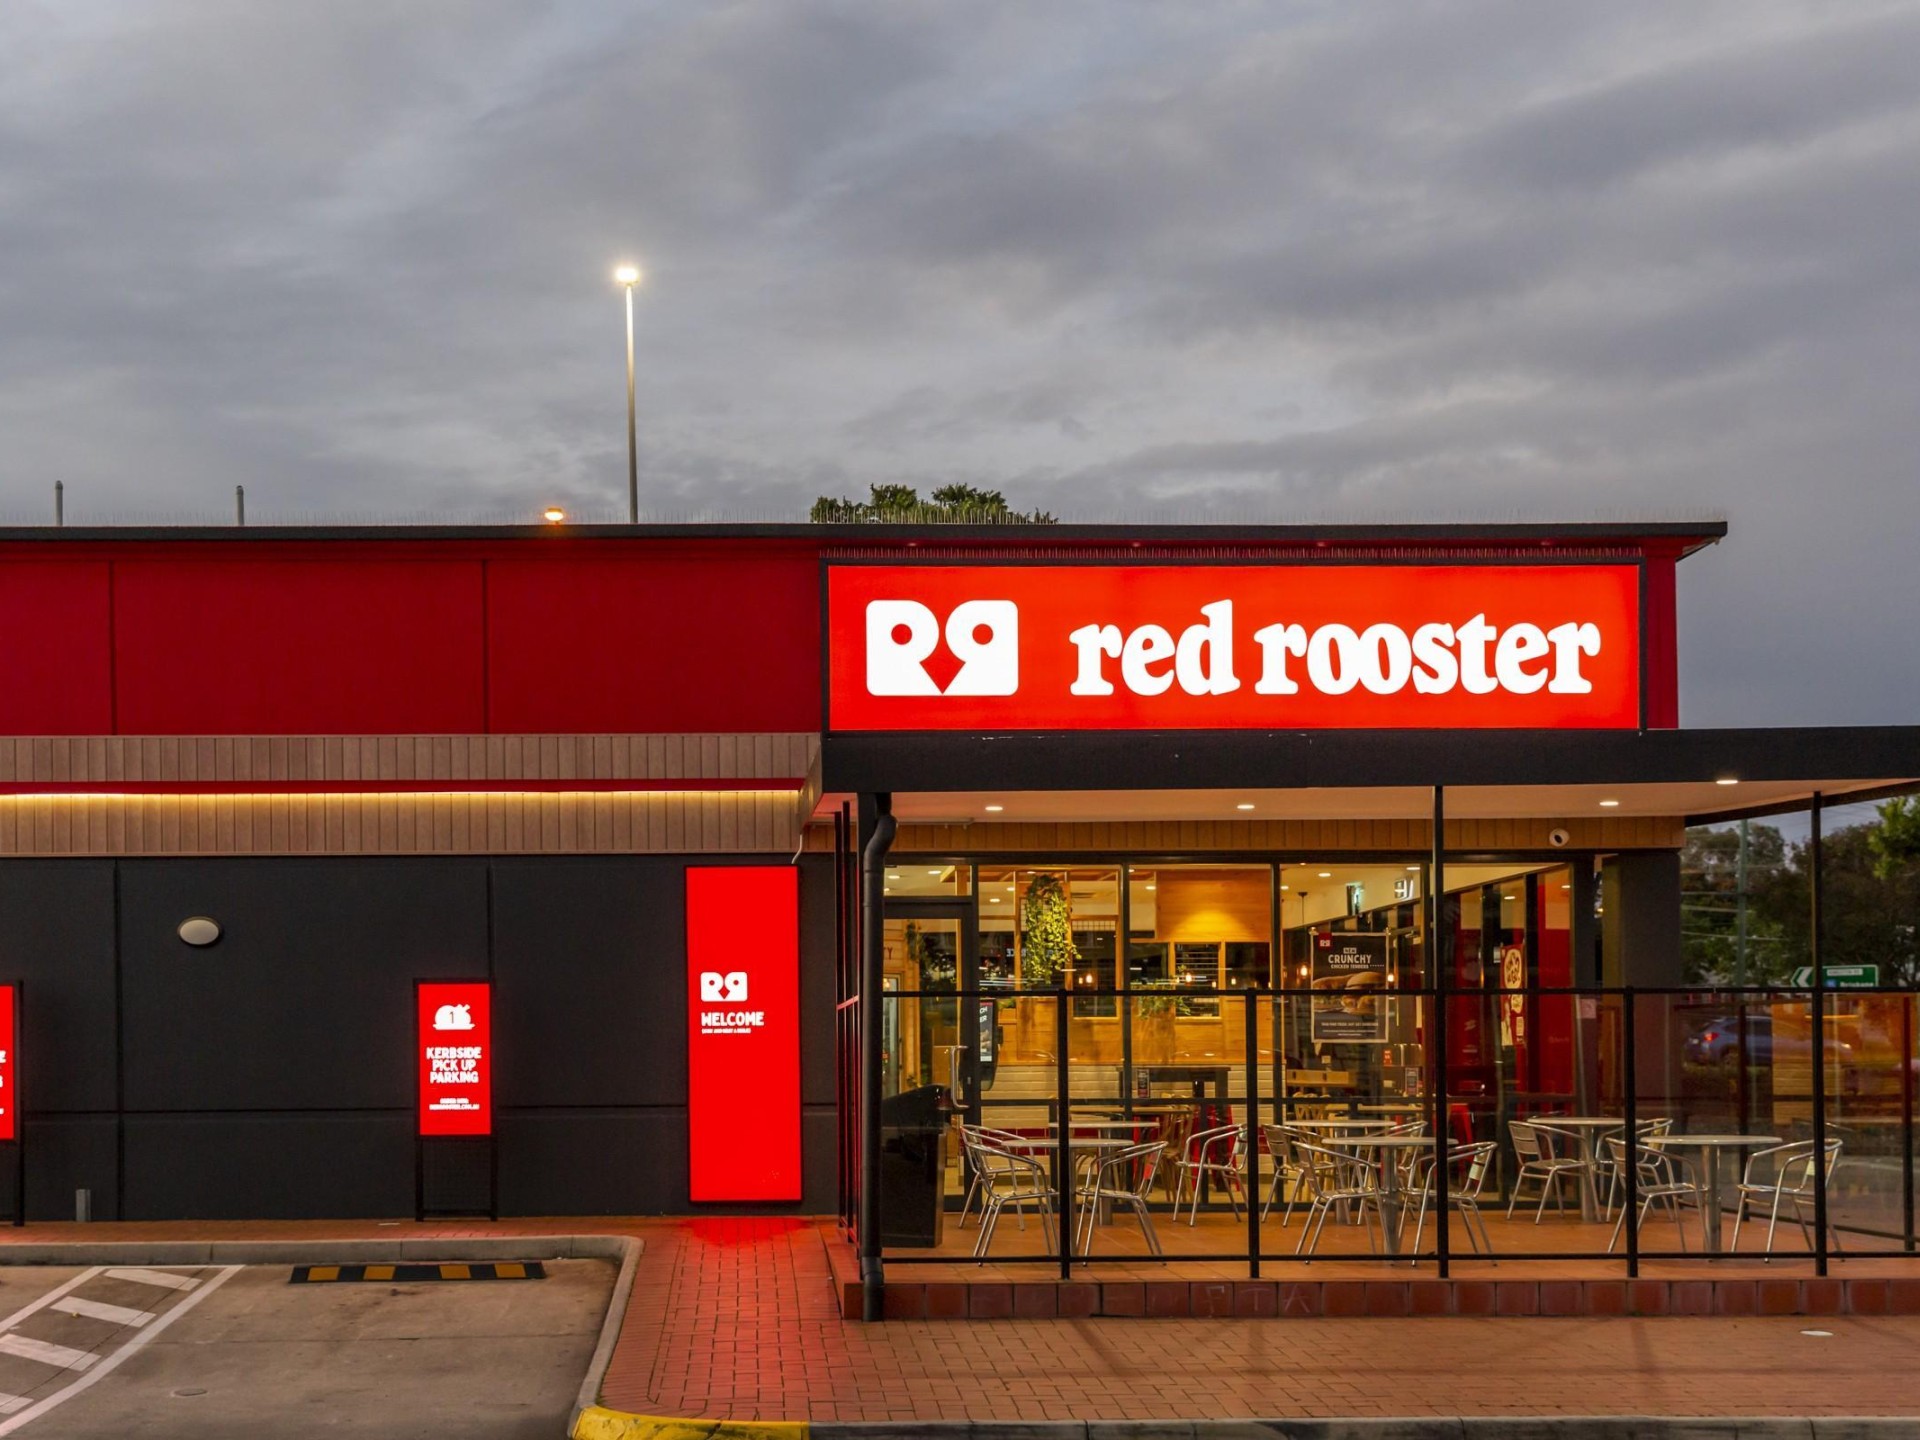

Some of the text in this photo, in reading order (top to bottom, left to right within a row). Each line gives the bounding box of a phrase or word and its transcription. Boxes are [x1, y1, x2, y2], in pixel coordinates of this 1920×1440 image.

[1069, 599, 1602, 697] red rooster
[1328, 954, 1372, 964] CRUNCHY
[701, 1011, 765, 1027] WELCOME
[426, 1046, 482, 1059] KERBSIDE
[432, 1059, 477, 1071] PICK UP
[430, 1071, 479, 1084] PARKING
